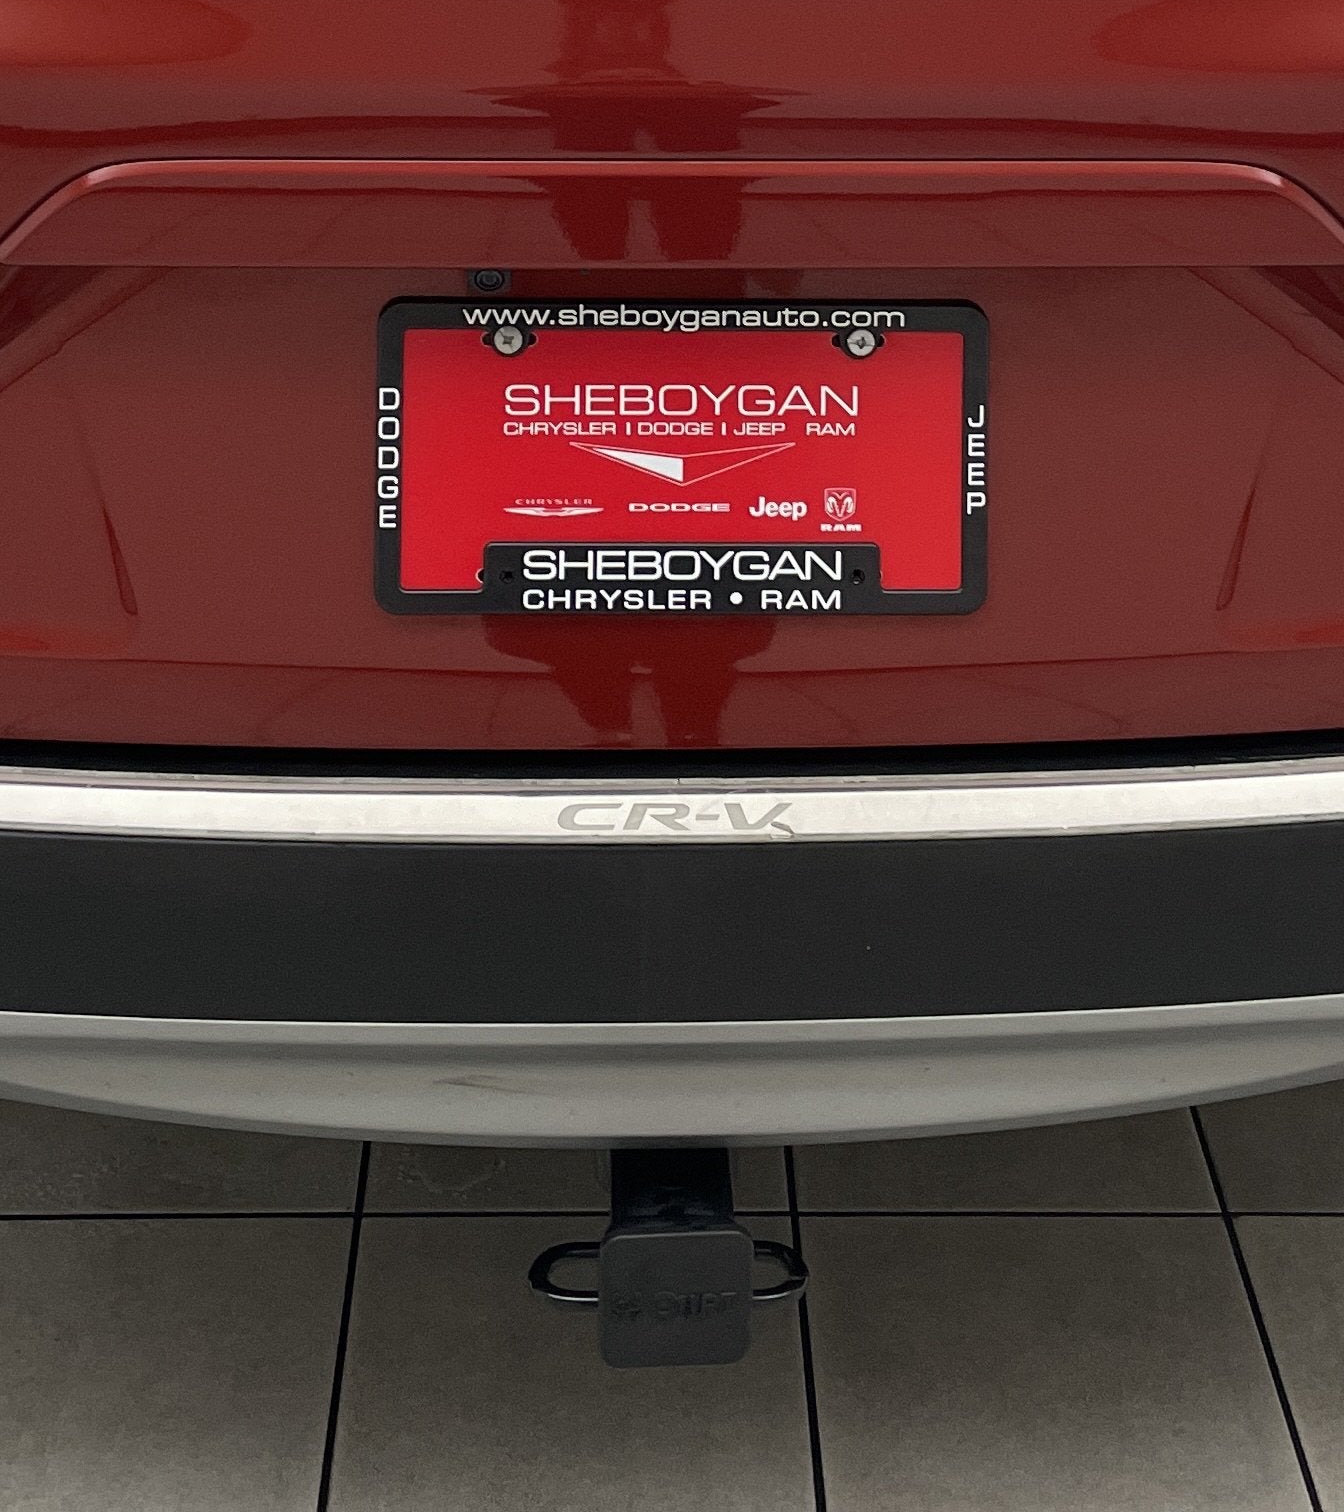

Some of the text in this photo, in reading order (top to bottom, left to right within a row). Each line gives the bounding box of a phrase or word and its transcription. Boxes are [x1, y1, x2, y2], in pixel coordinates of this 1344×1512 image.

[462, 302, 906, 331] www.sheboyganauto.com
[504, 384, 859, 417] SHEBOYGAN
[503, 422, 856, 437] CHRYSLER DODGE JEEP RAM
[377, 387, 400, 529] DODGE
[966, 404, 987, 515] JEEP
[628, 502, 731, 513] DODGE
[749, 496, 808, 521] Jeep
[820, 523, 862, 533] RAM
[522, 550, 843, 581] SHEBOYGAN
[522, 590, 843, 611] CHRYSLER RAM
[557, 802, 792, 831] CR-V
